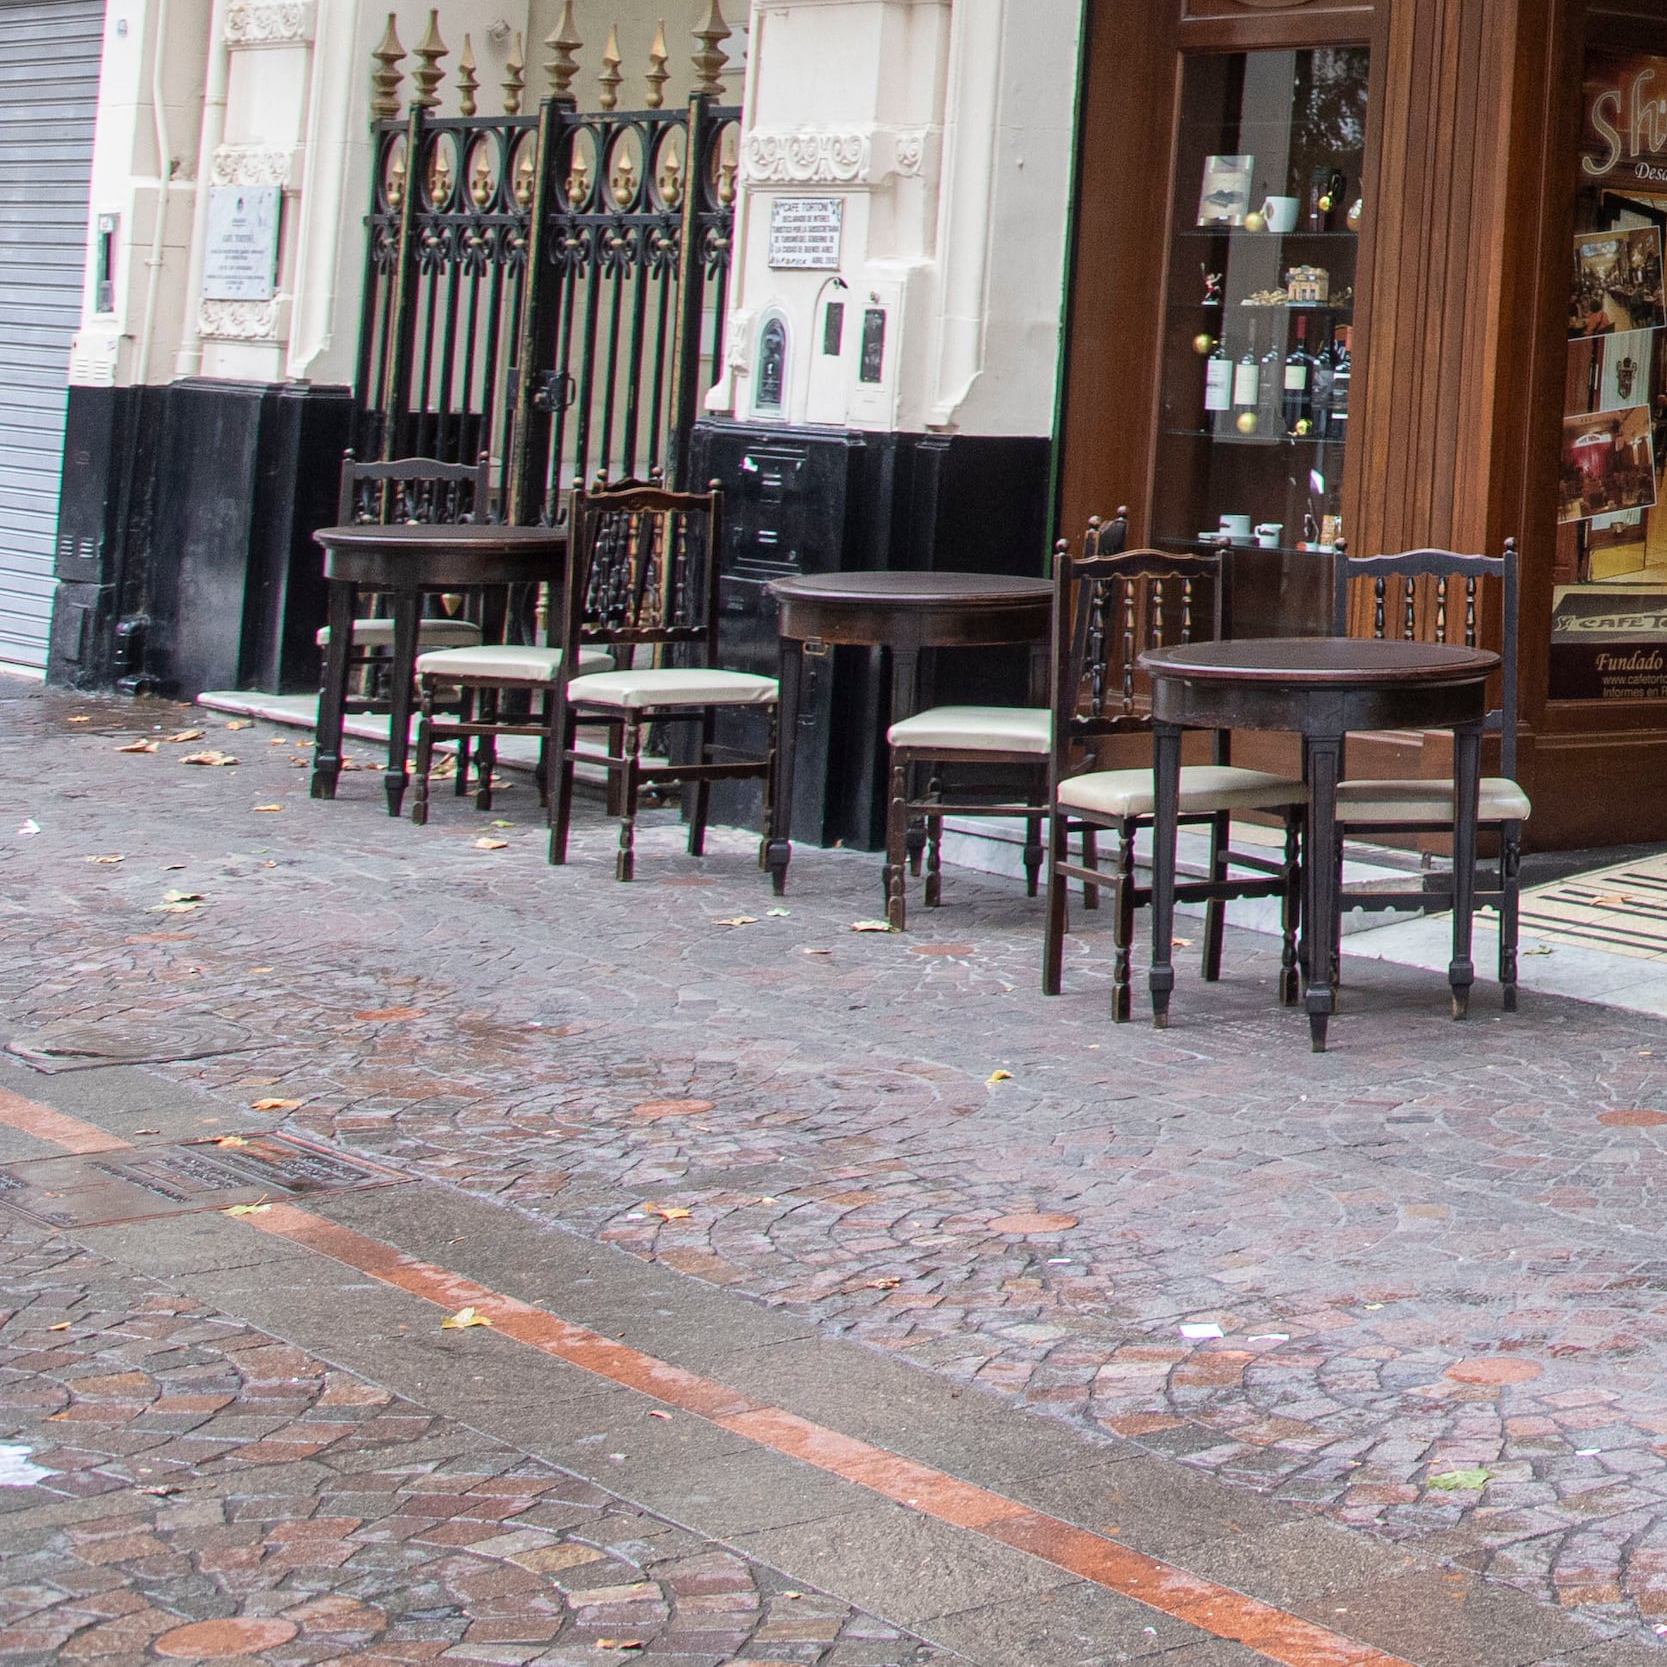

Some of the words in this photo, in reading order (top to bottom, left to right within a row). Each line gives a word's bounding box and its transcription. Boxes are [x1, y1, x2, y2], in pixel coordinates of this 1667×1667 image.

[1579, 617, 1642, 628] CAFE
[1595, 651, 1662, 670] Fundado
[1603, 687, 1644, 698] Informes
